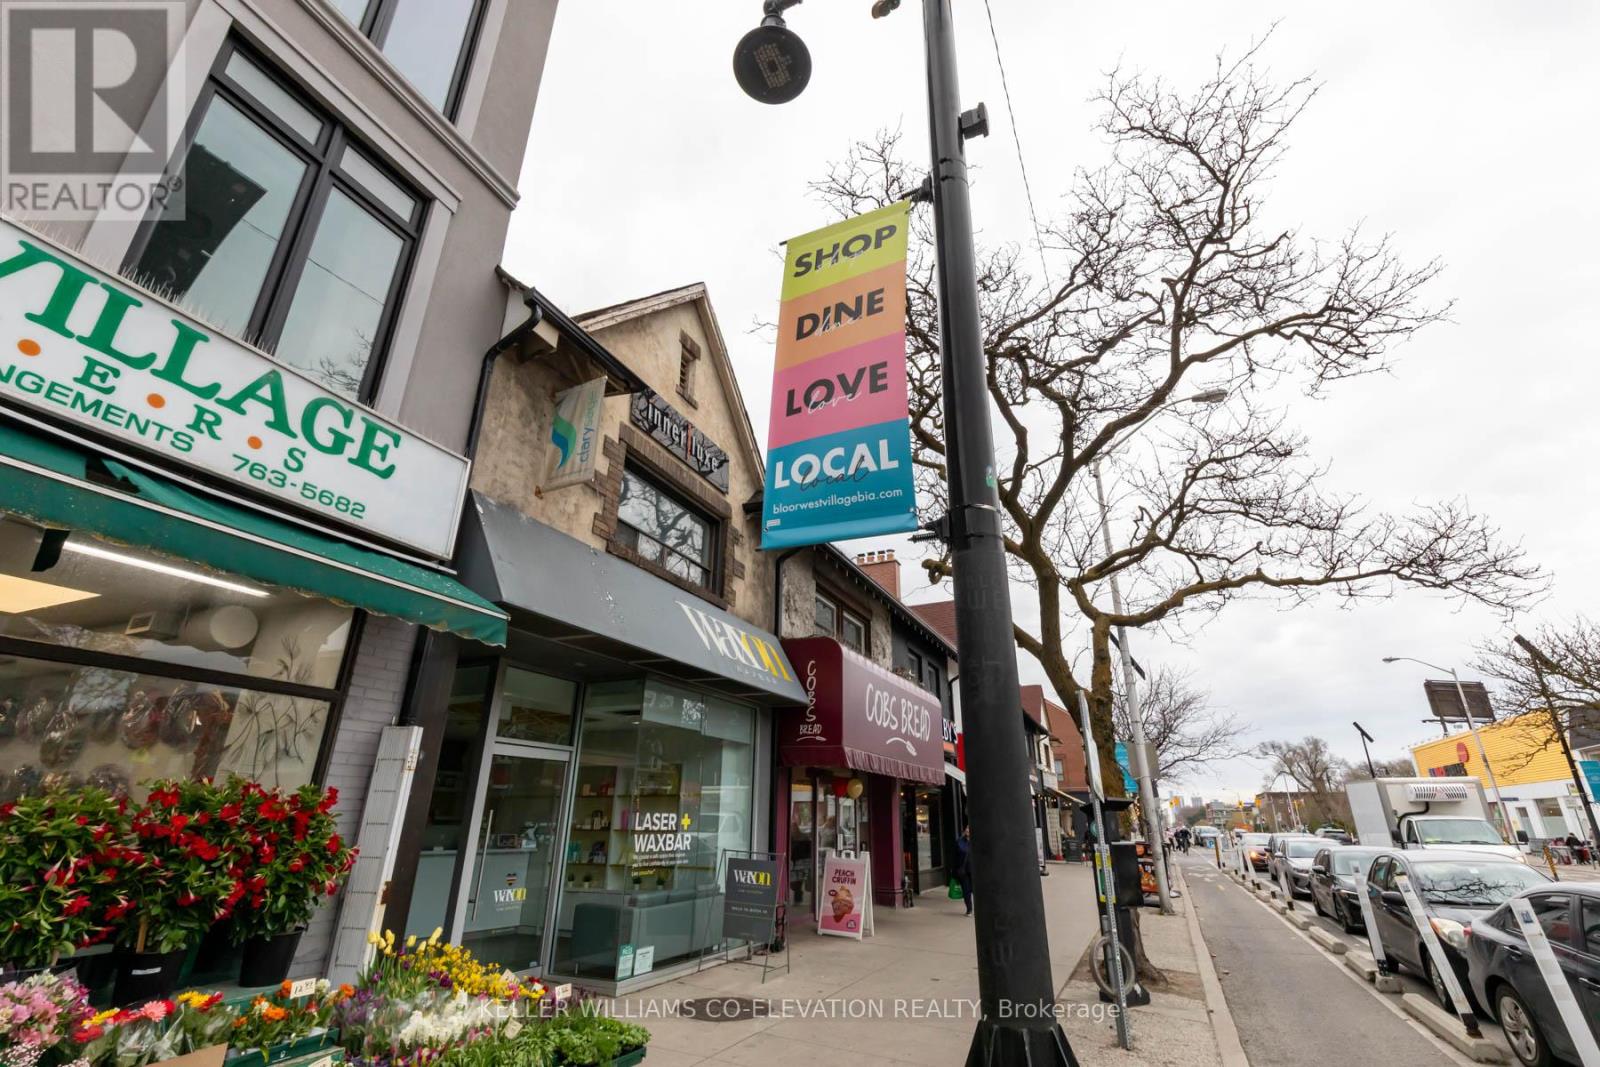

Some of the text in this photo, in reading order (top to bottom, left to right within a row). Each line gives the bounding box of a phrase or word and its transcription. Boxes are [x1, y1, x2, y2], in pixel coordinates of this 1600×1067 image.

[793, 225, 897, 278] SHOP
[795, 288, 885, 341] DINE
[786, 361, 888, 417] LOVE
[774, 439, 899, 489] LOCAL
[232, 453, 366, 519] 763-5682
[773, 489, 903, 514] bloorwestvillagebia.com
[799, 723, 822, 735] BREAD
[866, 683, 931, 742] COBS BREAD
[635, 812, 677, 831] LASER
[634, 833, 692, 853] WAXBAR
[832, 876, 857, 886] CRUFFIN
[834, 868, 855, 877] PEACH
